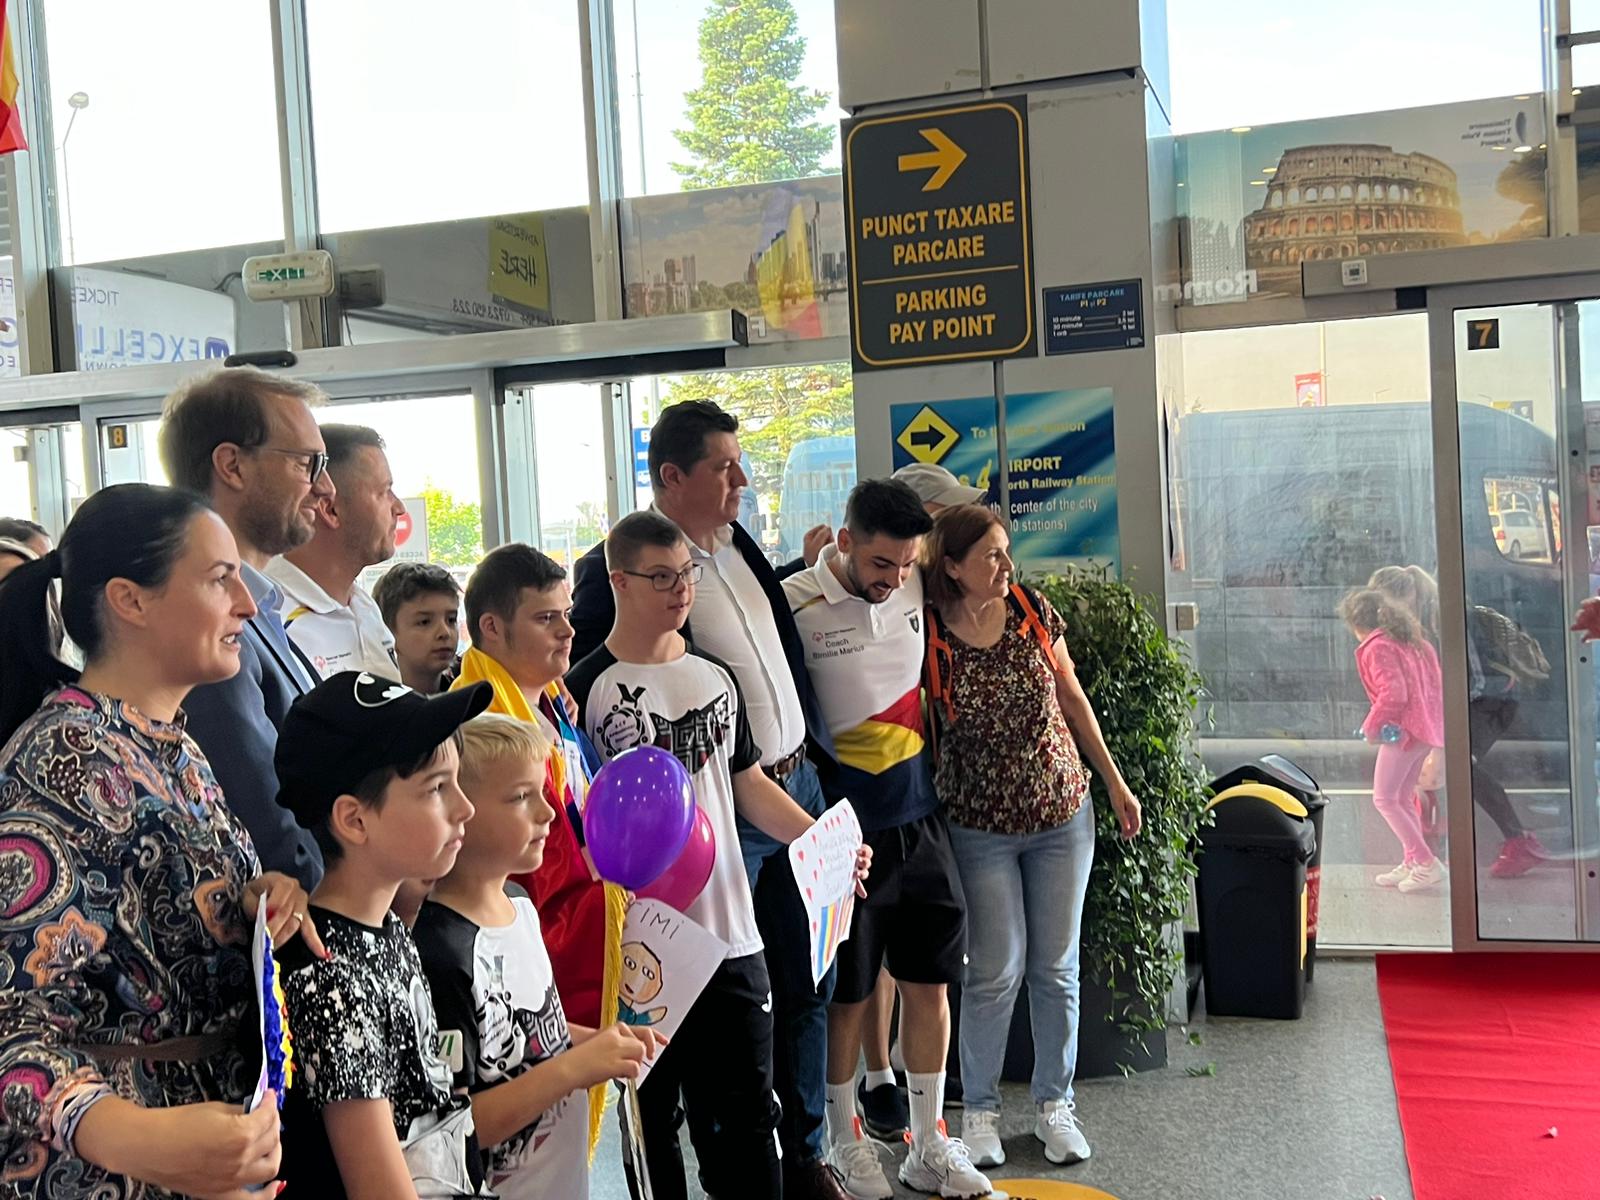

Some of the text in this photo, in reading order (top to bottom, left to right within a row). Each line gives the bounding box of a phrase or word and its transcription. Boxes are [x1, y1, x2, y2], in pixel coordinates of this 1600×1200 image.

[862, 201, 1015, 239] PUNCT TAXARE
[893, 235, 985, 265] PARCARE
[895, 284, 986, 314] PARKING
[889, 314, 996, 344] PAY POINT
[1475, 323, 1493, 347] 7
[113, 427, 125, 447] 8
[970, 426, 987, 440] To
[1008, 456, 1062, 473] IRPORT
[1008, 479, 1029, 490] orth
[1032, 475, 1072, 489] Railway
[1010, 500, 1043, 514] center
[1047, 499, 1057, 512] of
[1059, 498, 1076, 511] the
[1079, 497, 1098, 513] city
[1022, 516, 1068, 532] stations)
[825, 637, 850, 649] Coach
